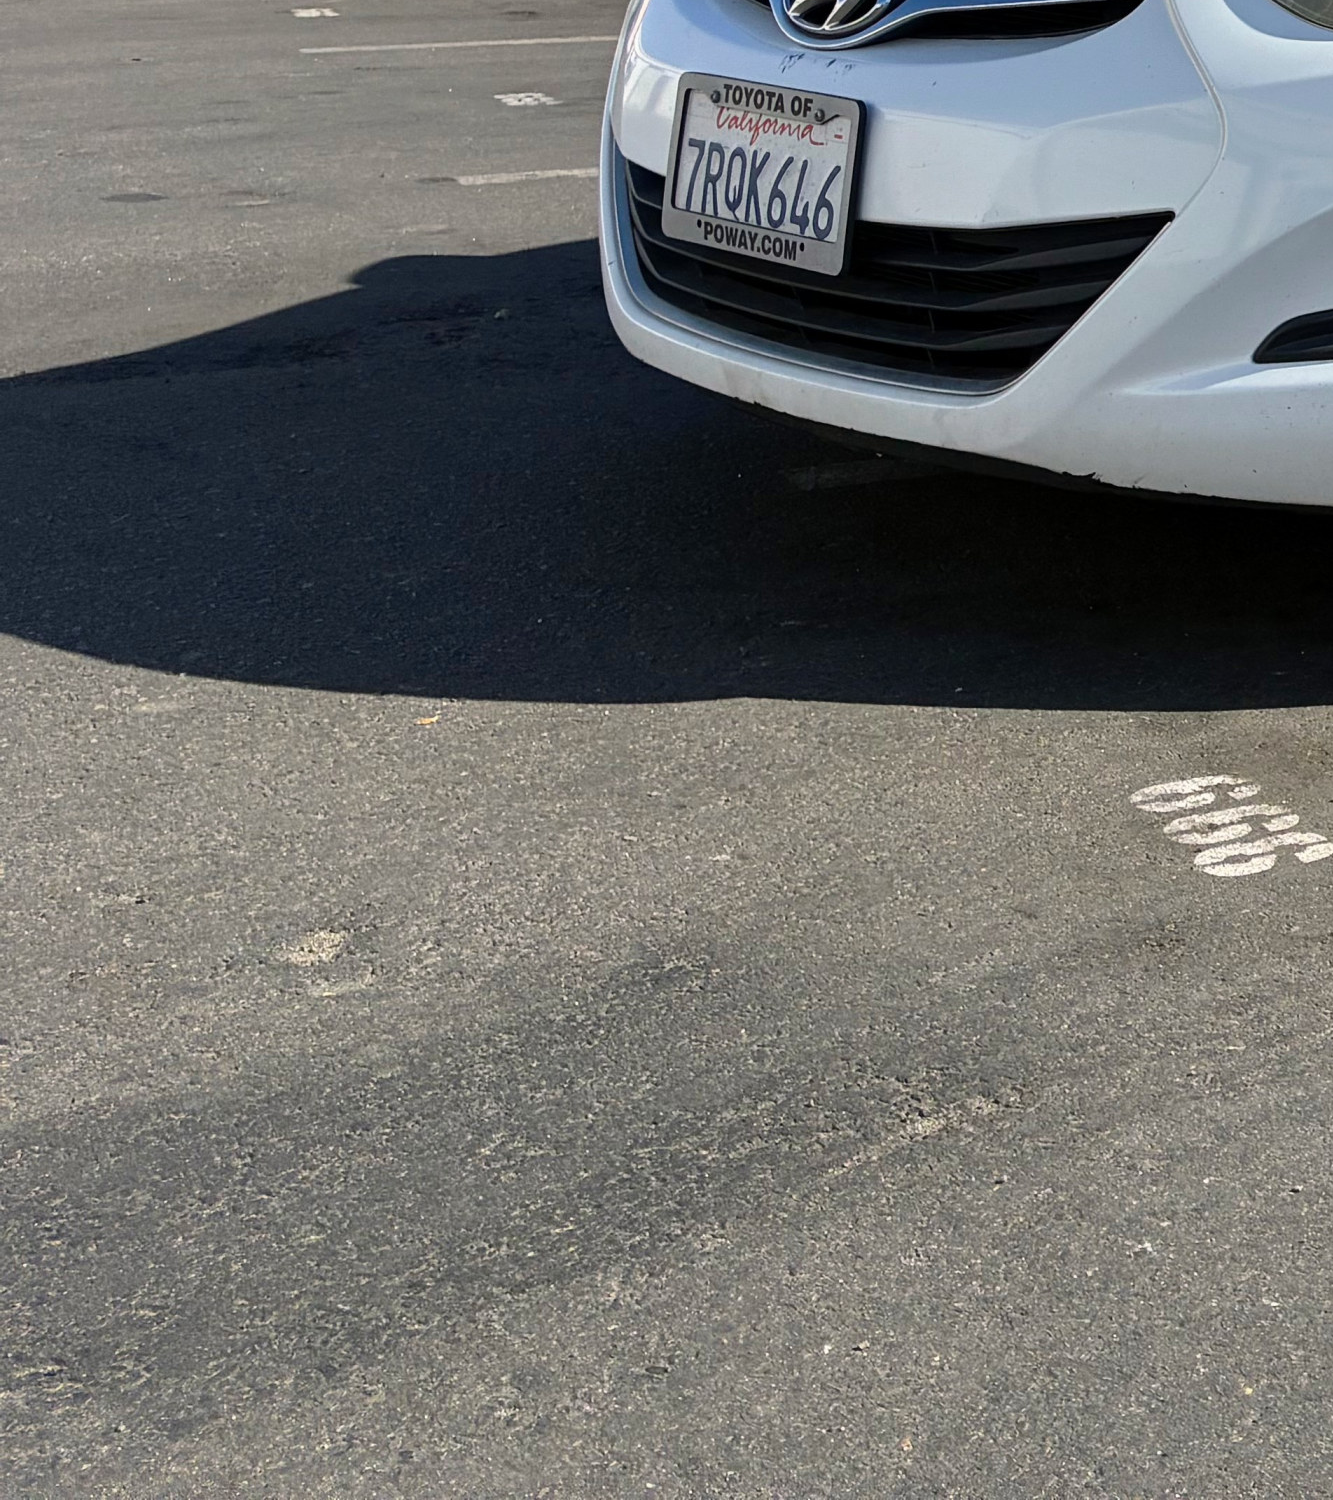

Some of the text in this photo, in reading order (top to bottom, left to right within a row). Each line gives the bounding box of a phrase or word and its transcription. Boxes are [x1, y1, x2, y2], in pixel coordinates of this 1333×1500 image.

[723, 84, 814, 118] TOYOTA OF
[716, 106, 825, 146] California
[685, 138, 842, 240] 7RQK646
[703, 221, 797, 261] POWAY.COM
